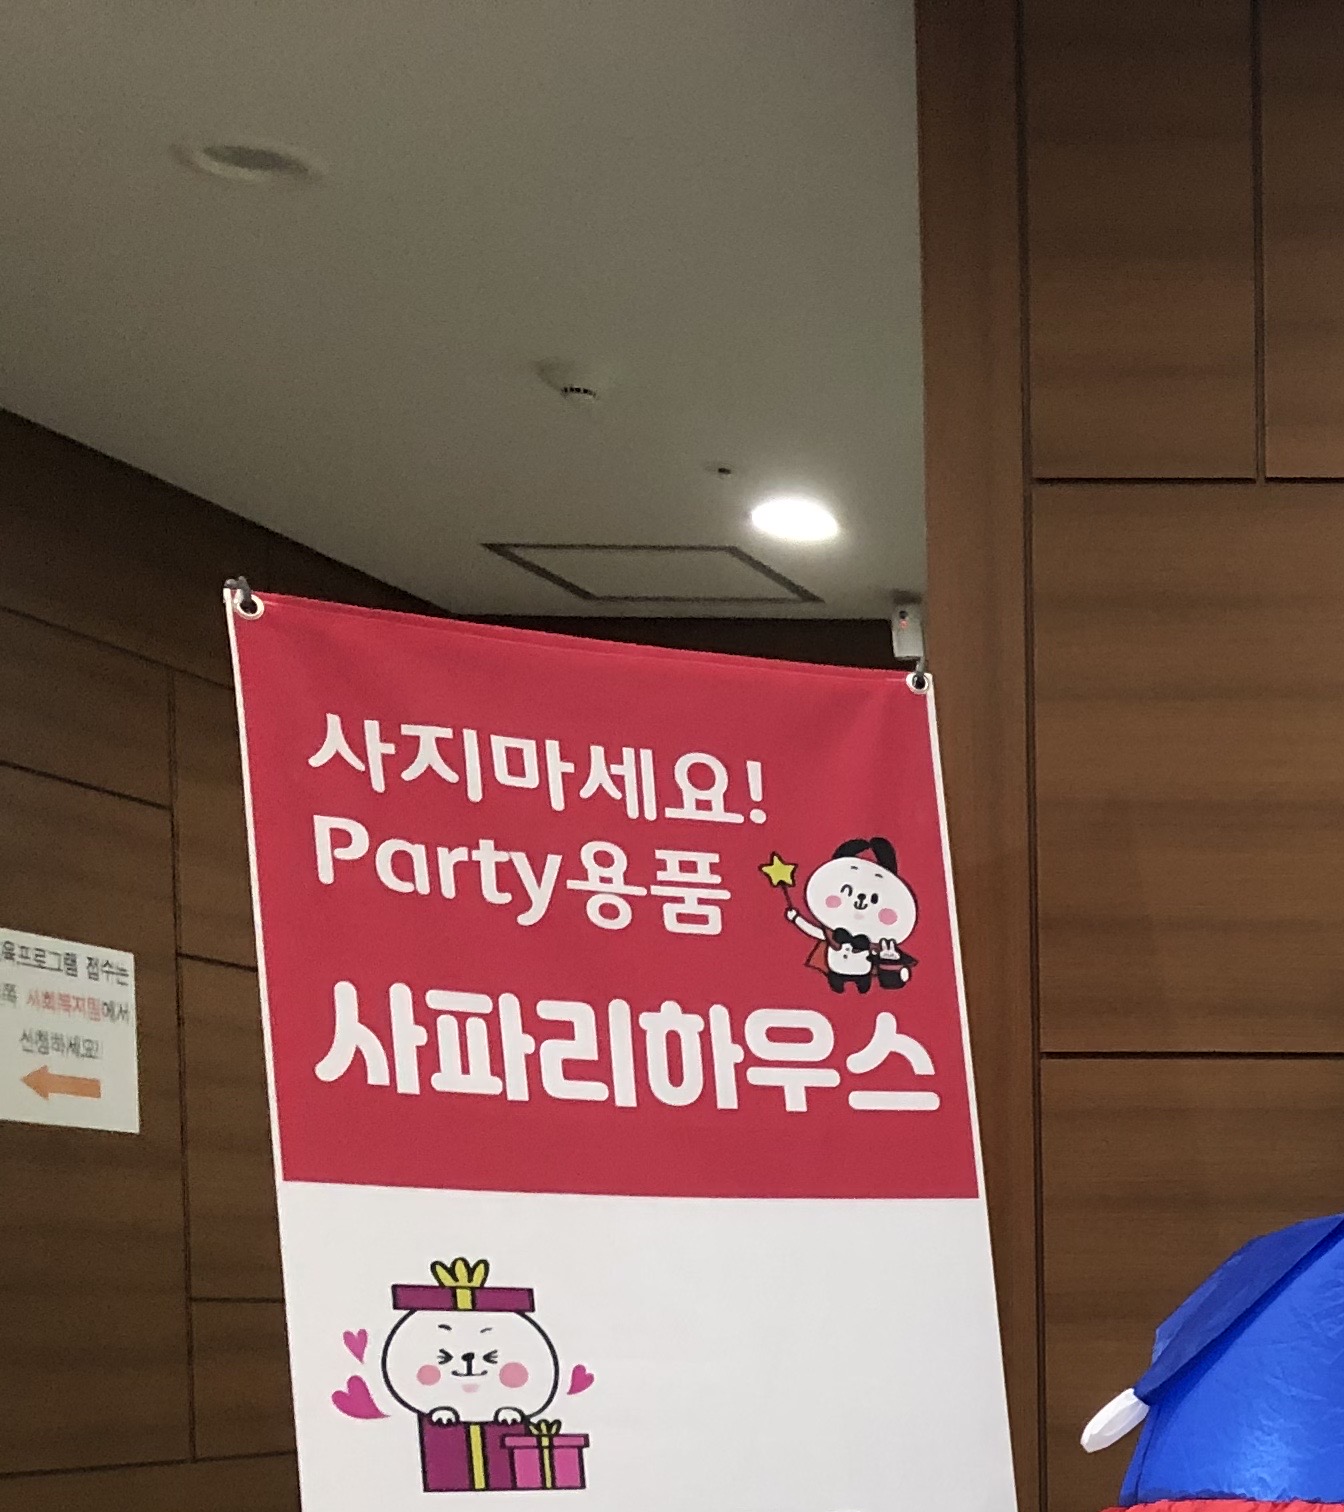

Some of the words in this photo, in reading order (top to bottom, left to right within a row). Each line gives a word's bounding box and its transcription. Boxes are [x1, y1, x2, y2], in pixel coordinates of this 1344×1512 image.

[308, 713, 768, 824] 사지마세요!
[313, 814, 732, 936] Party용품
[314, 980, 942, 1112] 사파리하우스
